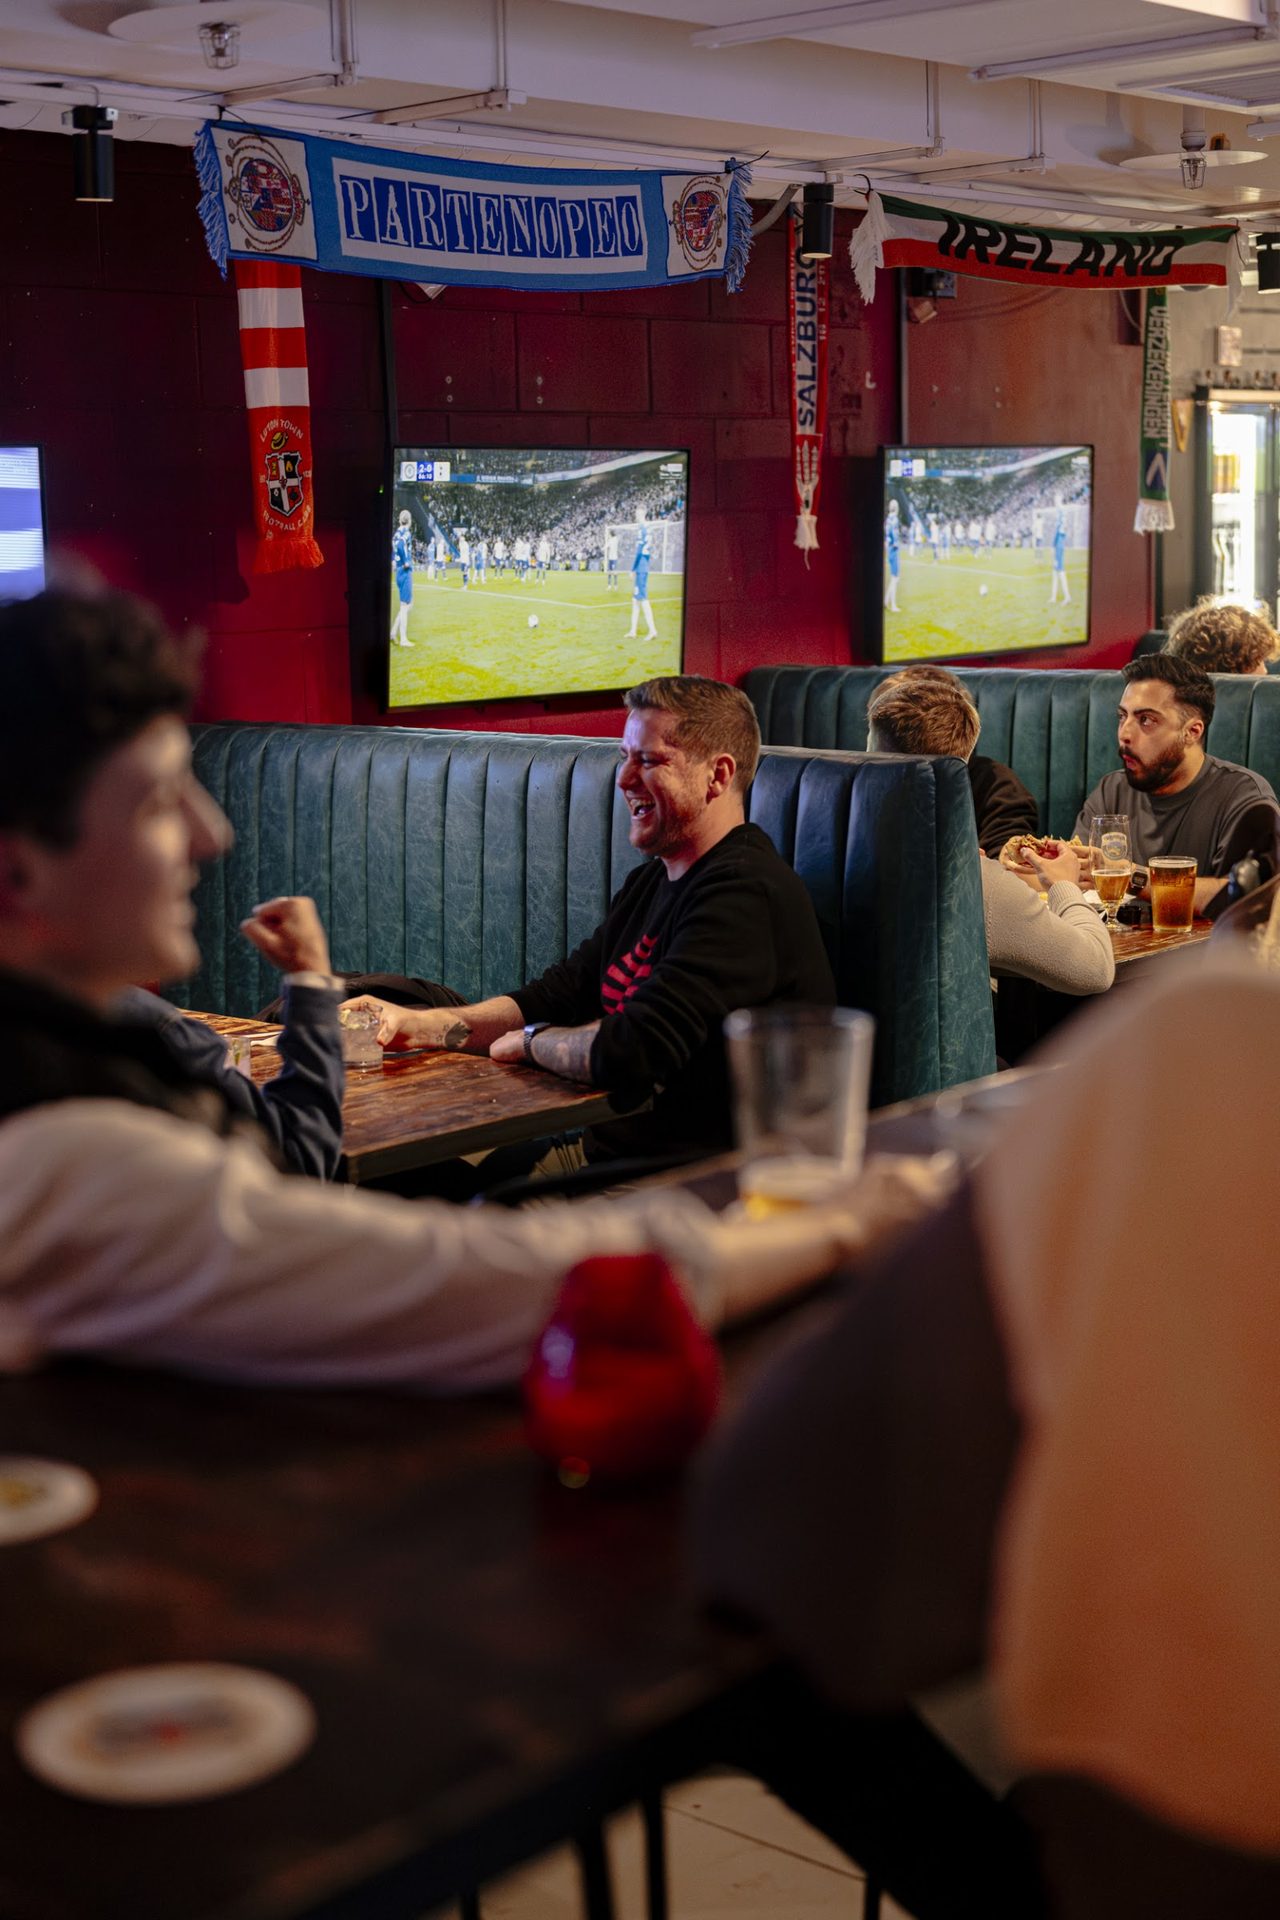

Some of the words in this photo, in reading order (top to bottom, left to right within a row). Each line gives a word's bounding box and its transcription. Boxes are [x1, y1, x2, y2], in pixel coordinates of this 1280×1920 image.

[341, 176, 643, 259] PARTENOPEO
[937, 214, 1186, 278] IRELAND
[280, 419, 304, 439] TOWN
